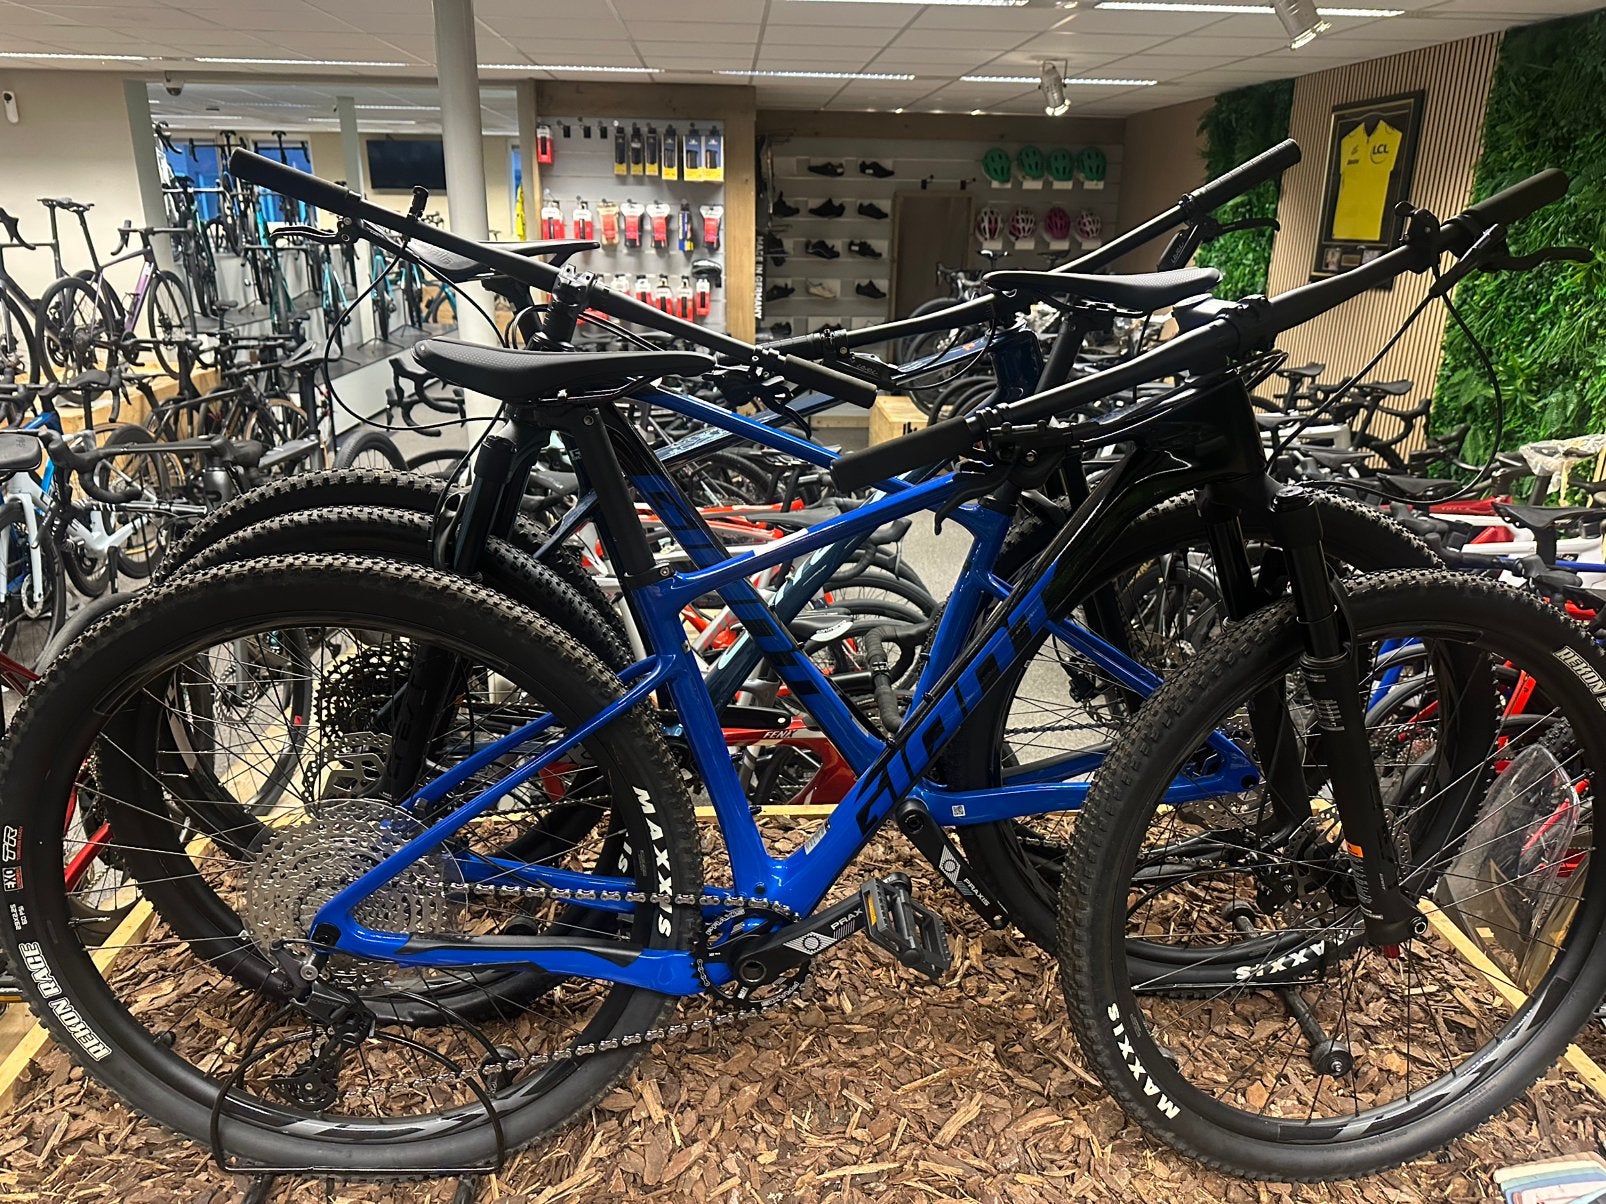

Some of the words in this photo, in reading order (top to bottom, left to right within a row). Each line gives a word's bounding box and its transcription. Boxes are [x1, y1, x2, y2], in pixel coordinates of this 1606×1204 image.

[1372, 143, 1389, 155] LCL
[755, 276, 763, 319] GERMANY
[848, 563, 1056, 836] GIANT
[2, 825, 17, 862] TR
[632, 786, 673, 938] MAXXIS
[4, 868, 16, 890] EXO
[962, 876, 991, 907] PRAXIS
[830, 907, 863, 929] PRAX
[19, 941, 62, 999] RACE
[49, 996, 112, 1062] REKON
[1107, 1001, 1181, 1120] MAXXIS
